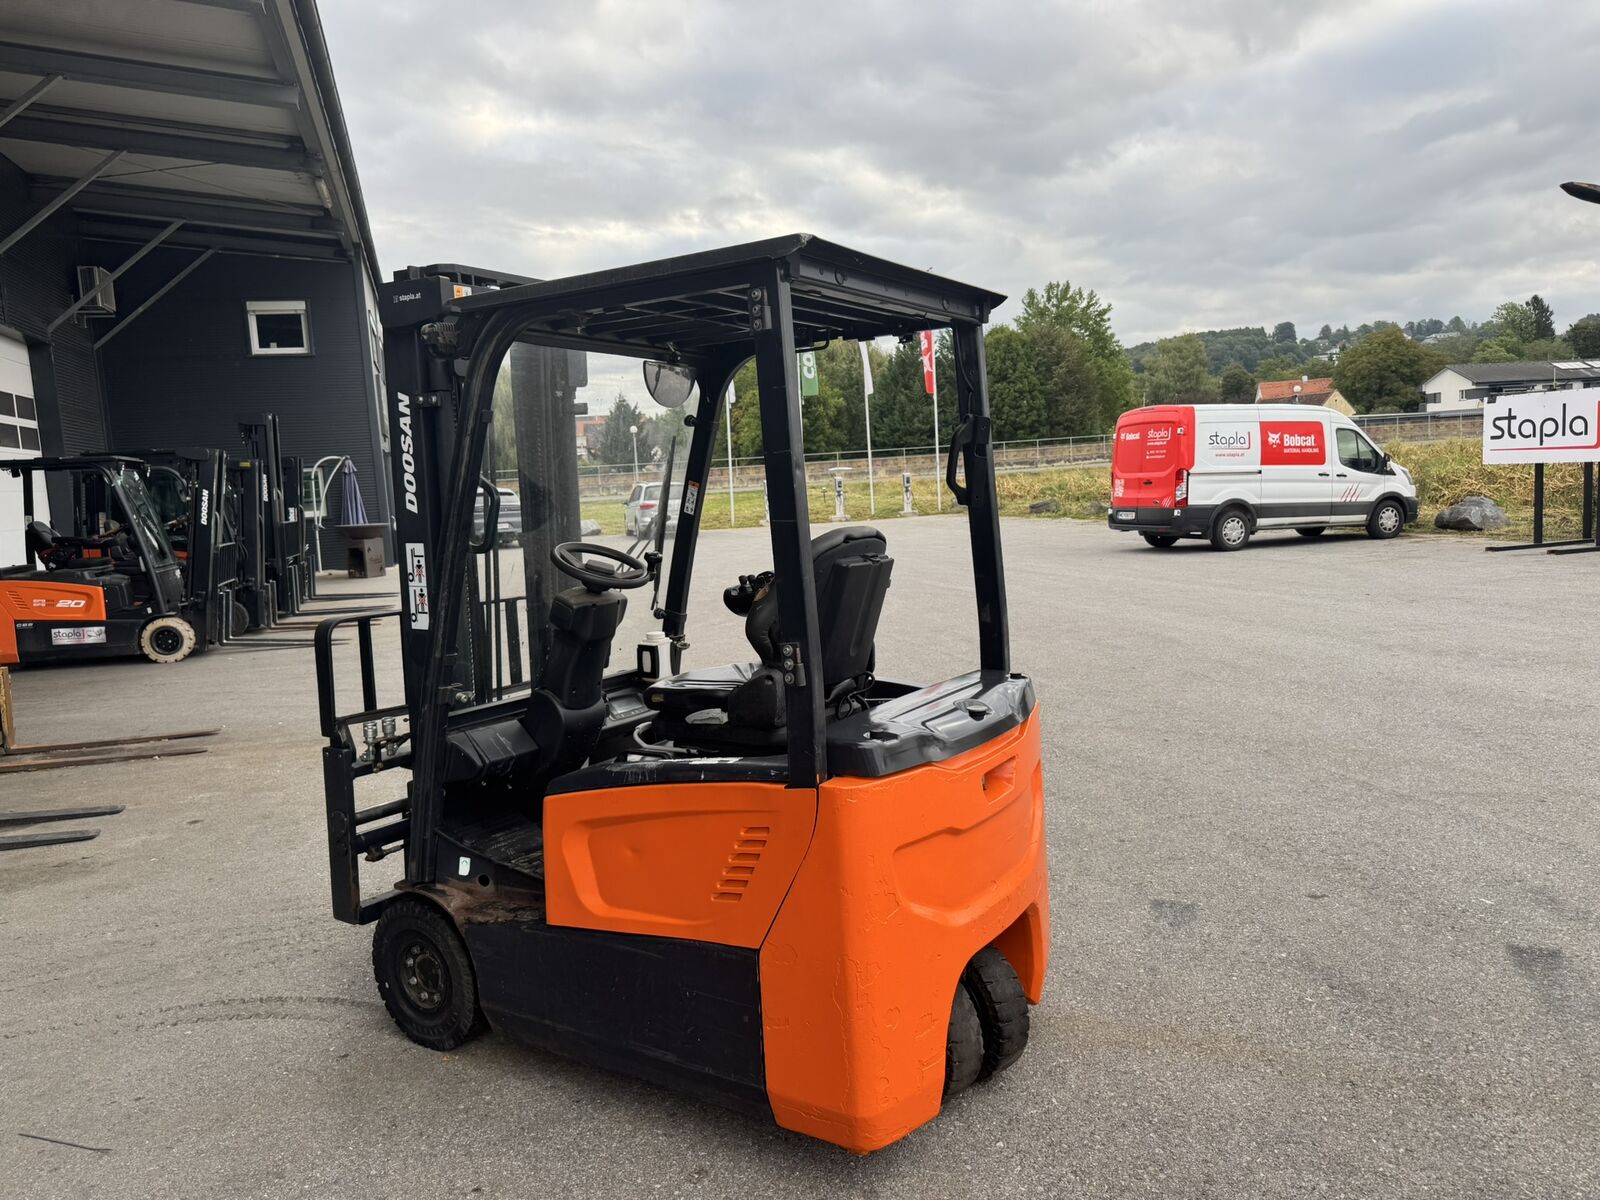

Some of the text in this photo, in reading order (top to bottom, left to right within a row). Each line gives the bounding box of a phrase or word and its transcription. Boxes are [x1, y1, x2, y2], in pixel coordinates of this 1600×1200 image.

[399, 292, 421, 302] stapla.at
[1490, 403, 1588, 446] stapla
[1147, 428, 1168, 440] stapla
[1208, 431, 1246, 448] stapla
[1283, 434, 1315, 447] Bobcat
[398, 392, 418, 514] DOOSAN
[201, 489, 209, 526] DOOSAN
[56, 600, 86, 608] 20
[53, 629, 82, 640] stapla
